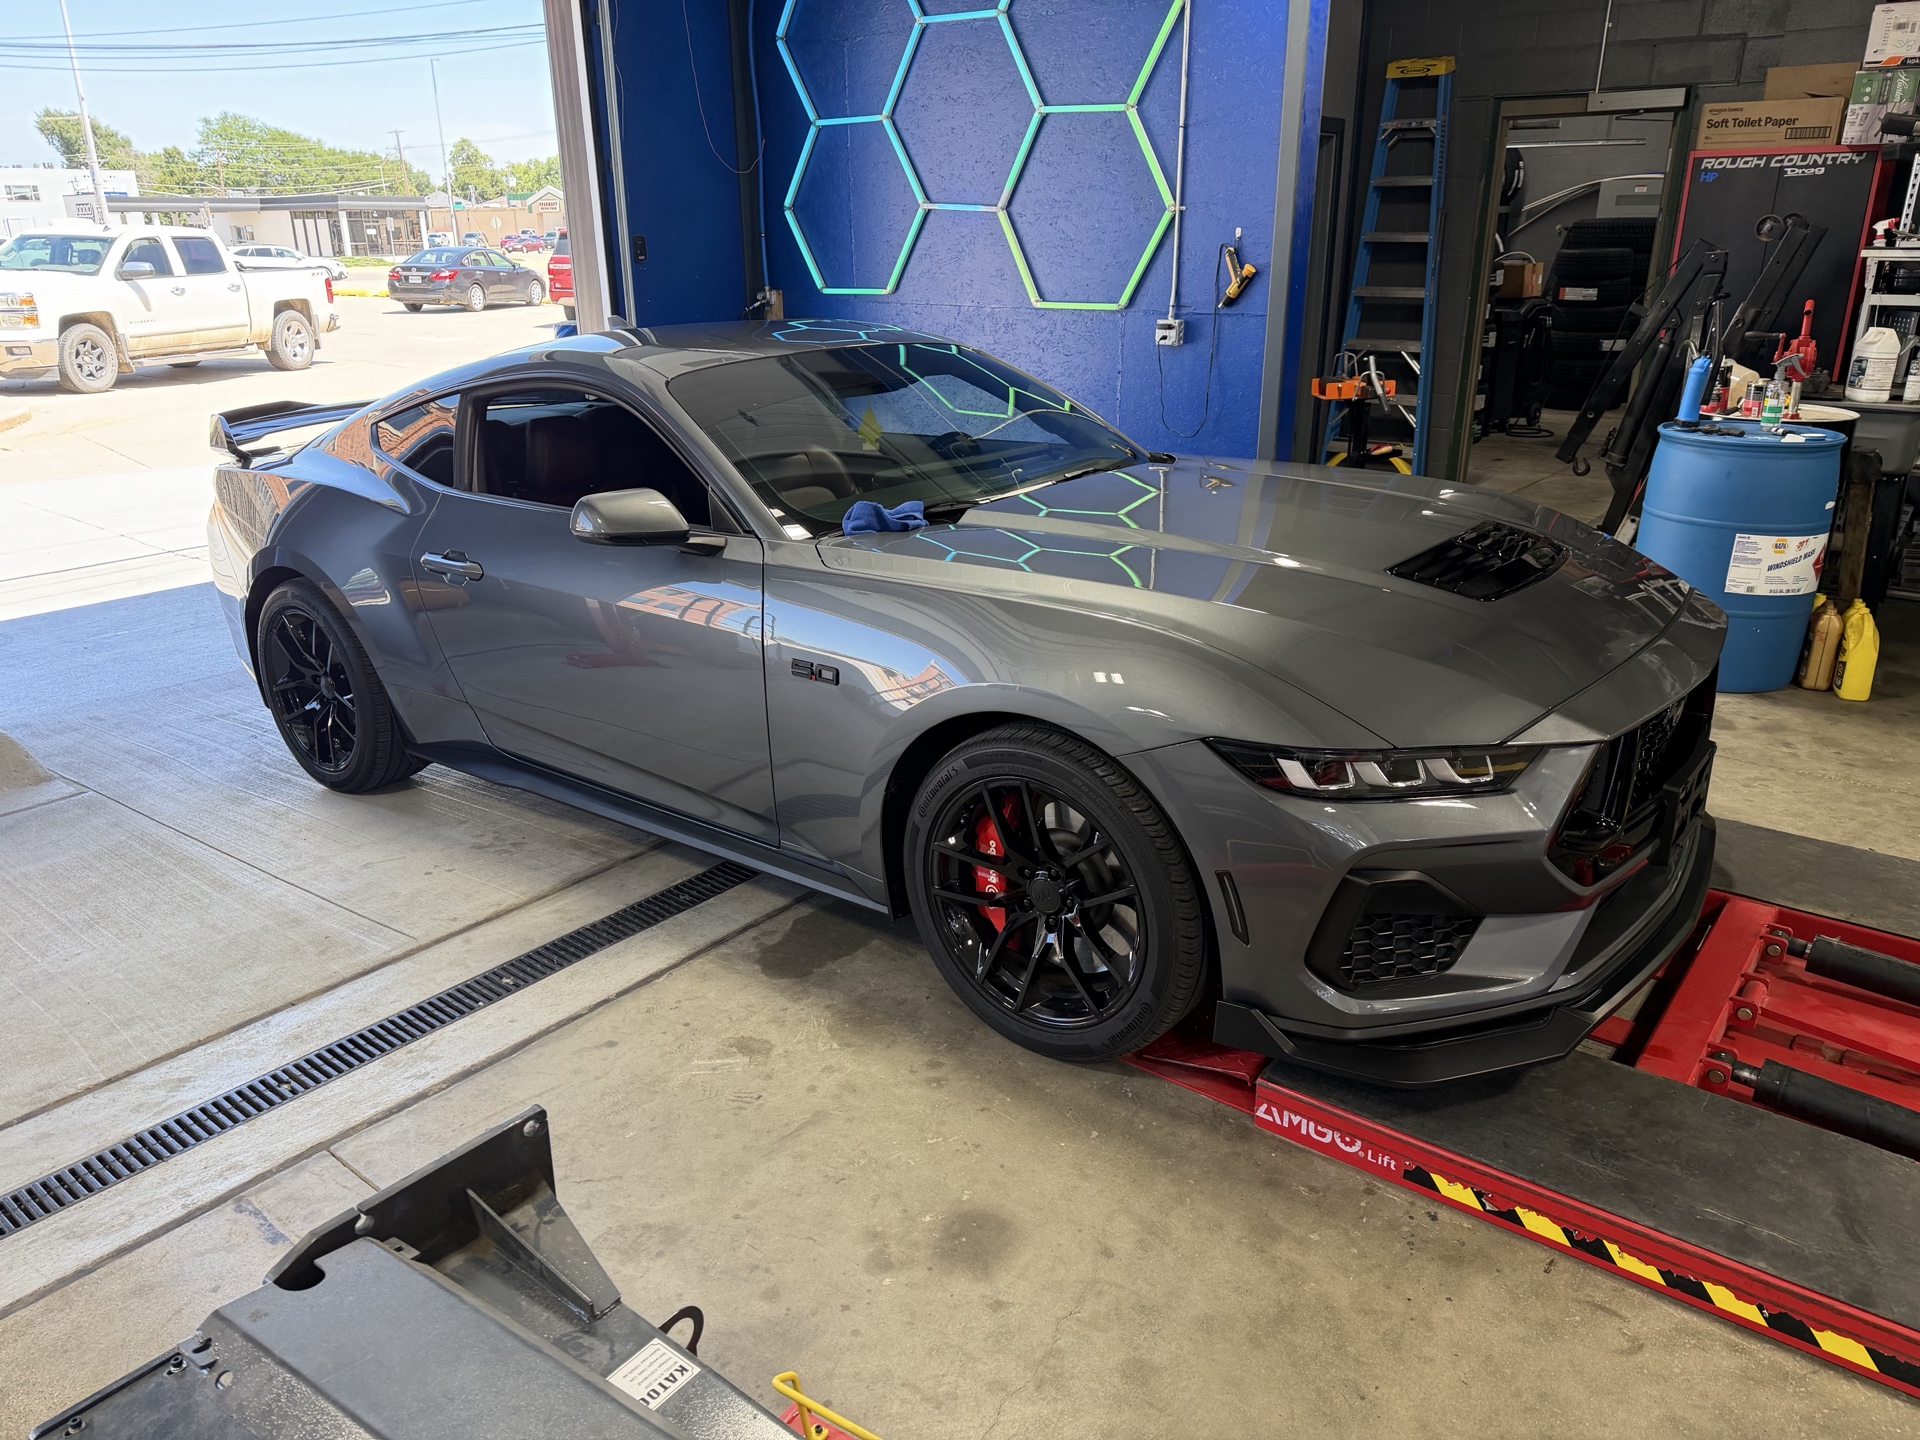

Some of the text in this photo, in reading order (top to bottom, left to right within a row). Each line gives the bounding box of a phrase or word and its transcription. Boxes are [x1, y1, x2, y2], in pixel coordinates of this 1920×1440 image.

[1893, 69, 1910, 102] Hunter
[1706, 116, 1799, 129] Soft Toilet Paper
[1708, 107, 1728, 115] amazon
[1700, 152, 1867, 170] ROUGH COUNTRY
[1699, 172, 1719, 183] HP
[1774, 542, 1787, 550] NAPA
[1766, 554, 1803, 572] WINDSHIELD
[1802, 547, 1817, 560] WASH
[791, 657, 840, 687] 5.0
[917, 769, 954, 818] Continental
[987, 839, 998, 885] brbo
[1107, 1001, 1153, 1048] Continental
[1367, 1149, 1397, 1171] Lift
